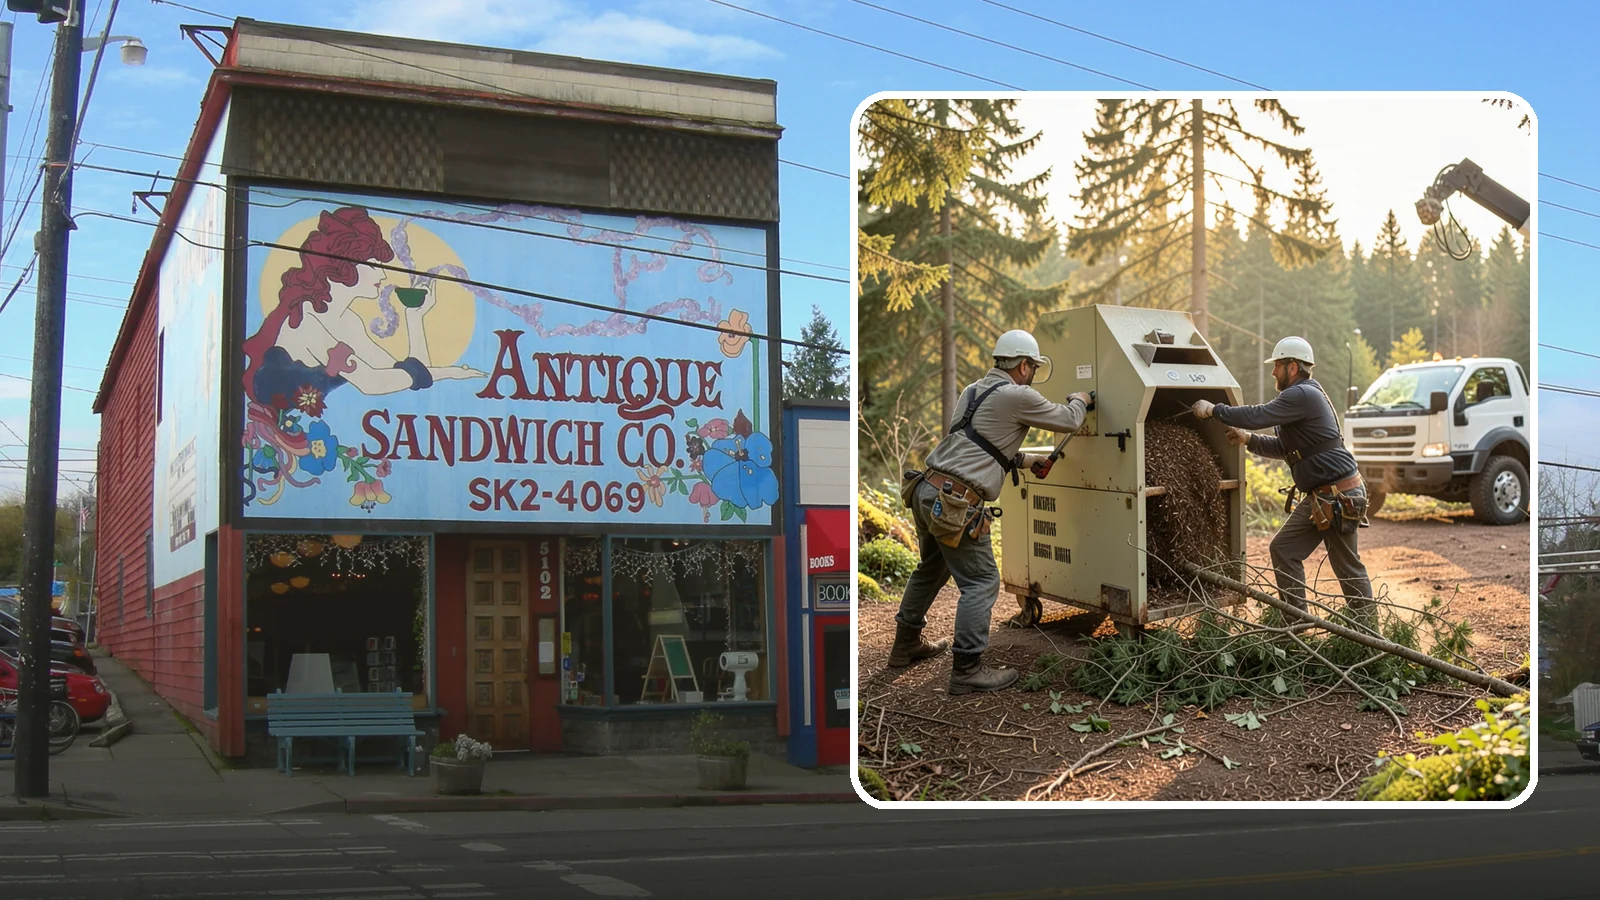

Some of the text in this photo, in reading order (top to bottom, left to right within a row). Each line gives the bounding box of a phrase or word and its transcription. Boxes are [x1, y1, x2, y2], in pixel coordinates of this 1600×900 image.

[475, 328, 724, 421] ANTIQUE
[361, 408, 685, 469] SANDWICH CO.
[468, 477, 645, 513] SK2-4069
[539, 541, 552, 600] 5102
[809, 555, 835, 569] BOOKS
